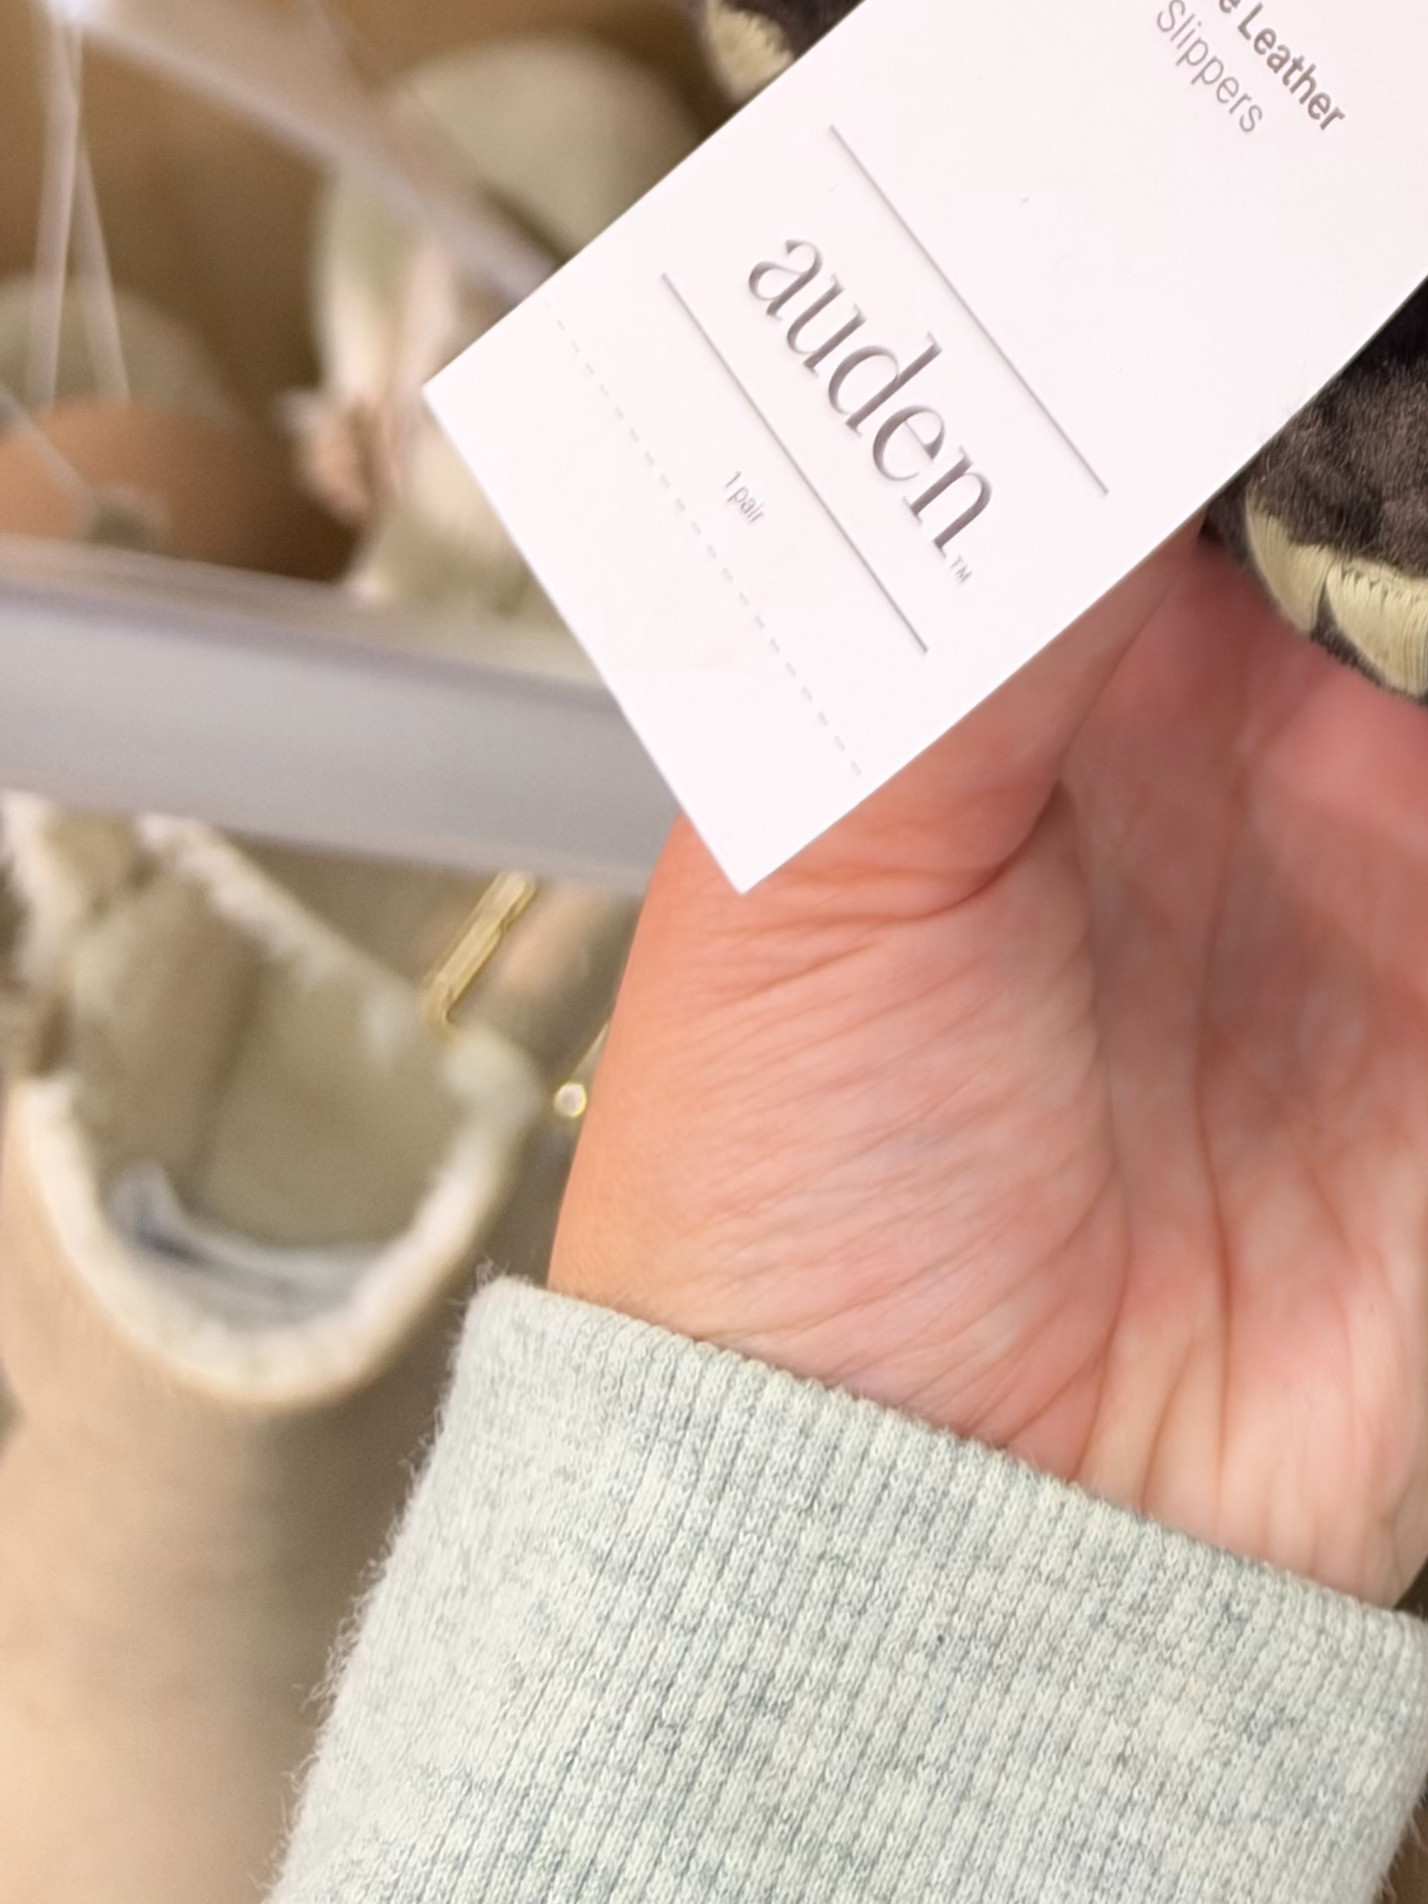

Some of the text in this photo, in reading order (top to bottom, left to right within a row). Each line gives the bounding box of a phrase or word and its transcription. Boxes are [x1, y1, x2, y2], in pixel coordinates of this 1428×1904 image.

[1237, 2, 1346, 131] Leather
[725, 471, 765, 525] 1 pair
